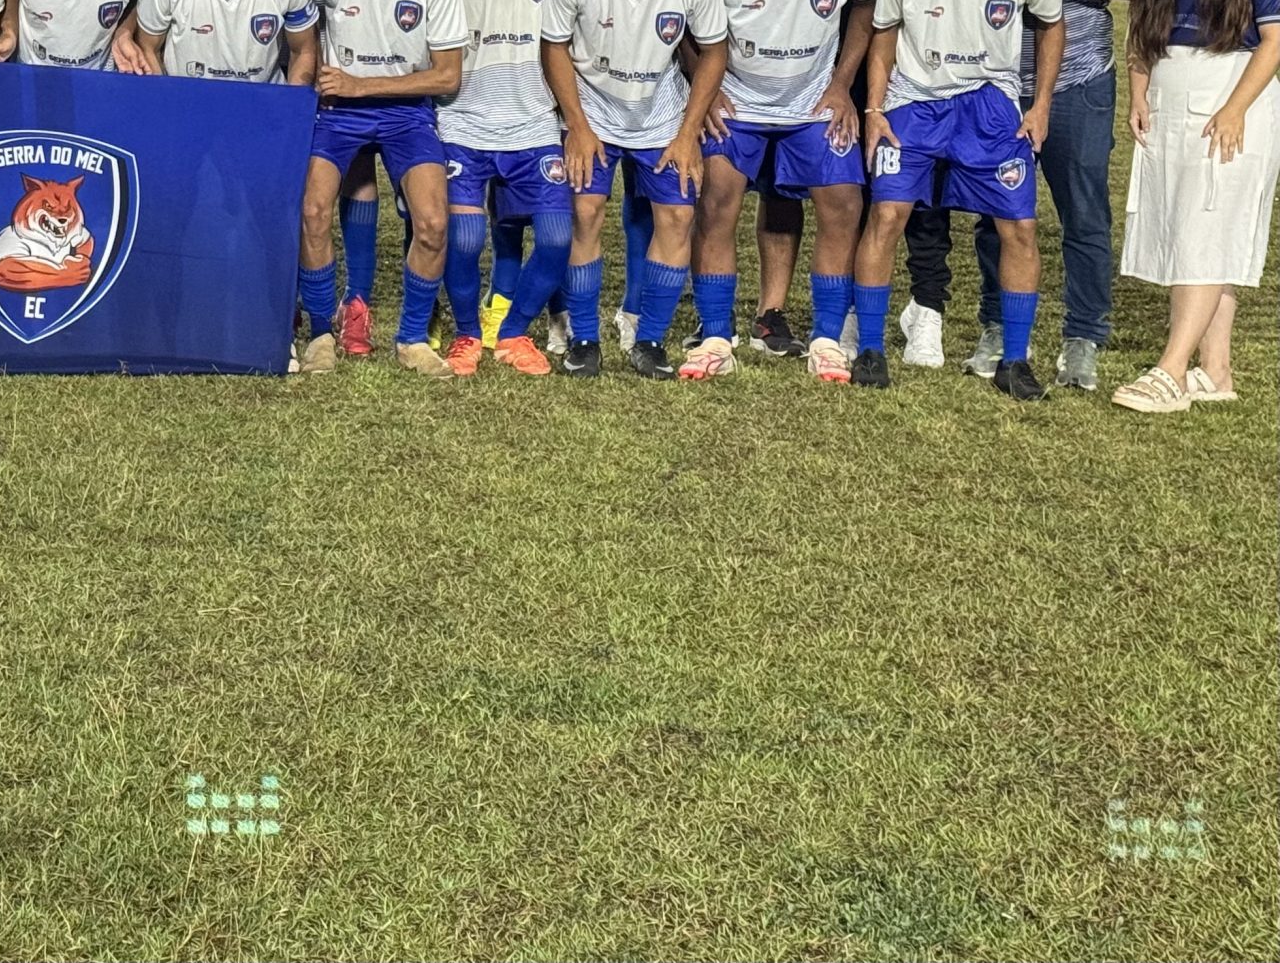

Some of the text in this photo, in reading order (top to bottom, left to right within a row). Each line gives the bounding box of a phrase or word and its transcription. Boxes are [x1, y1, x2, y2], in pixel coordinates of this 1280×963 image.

[509, 34, 518, 42] DO
[759, 48, 788, 56] SERRA
[50, 145, 72, 165] DO
[75, 149, 104, 174] MEL
[876, 145, 901, 178] 18
[24, 296, 46, 319] EC
